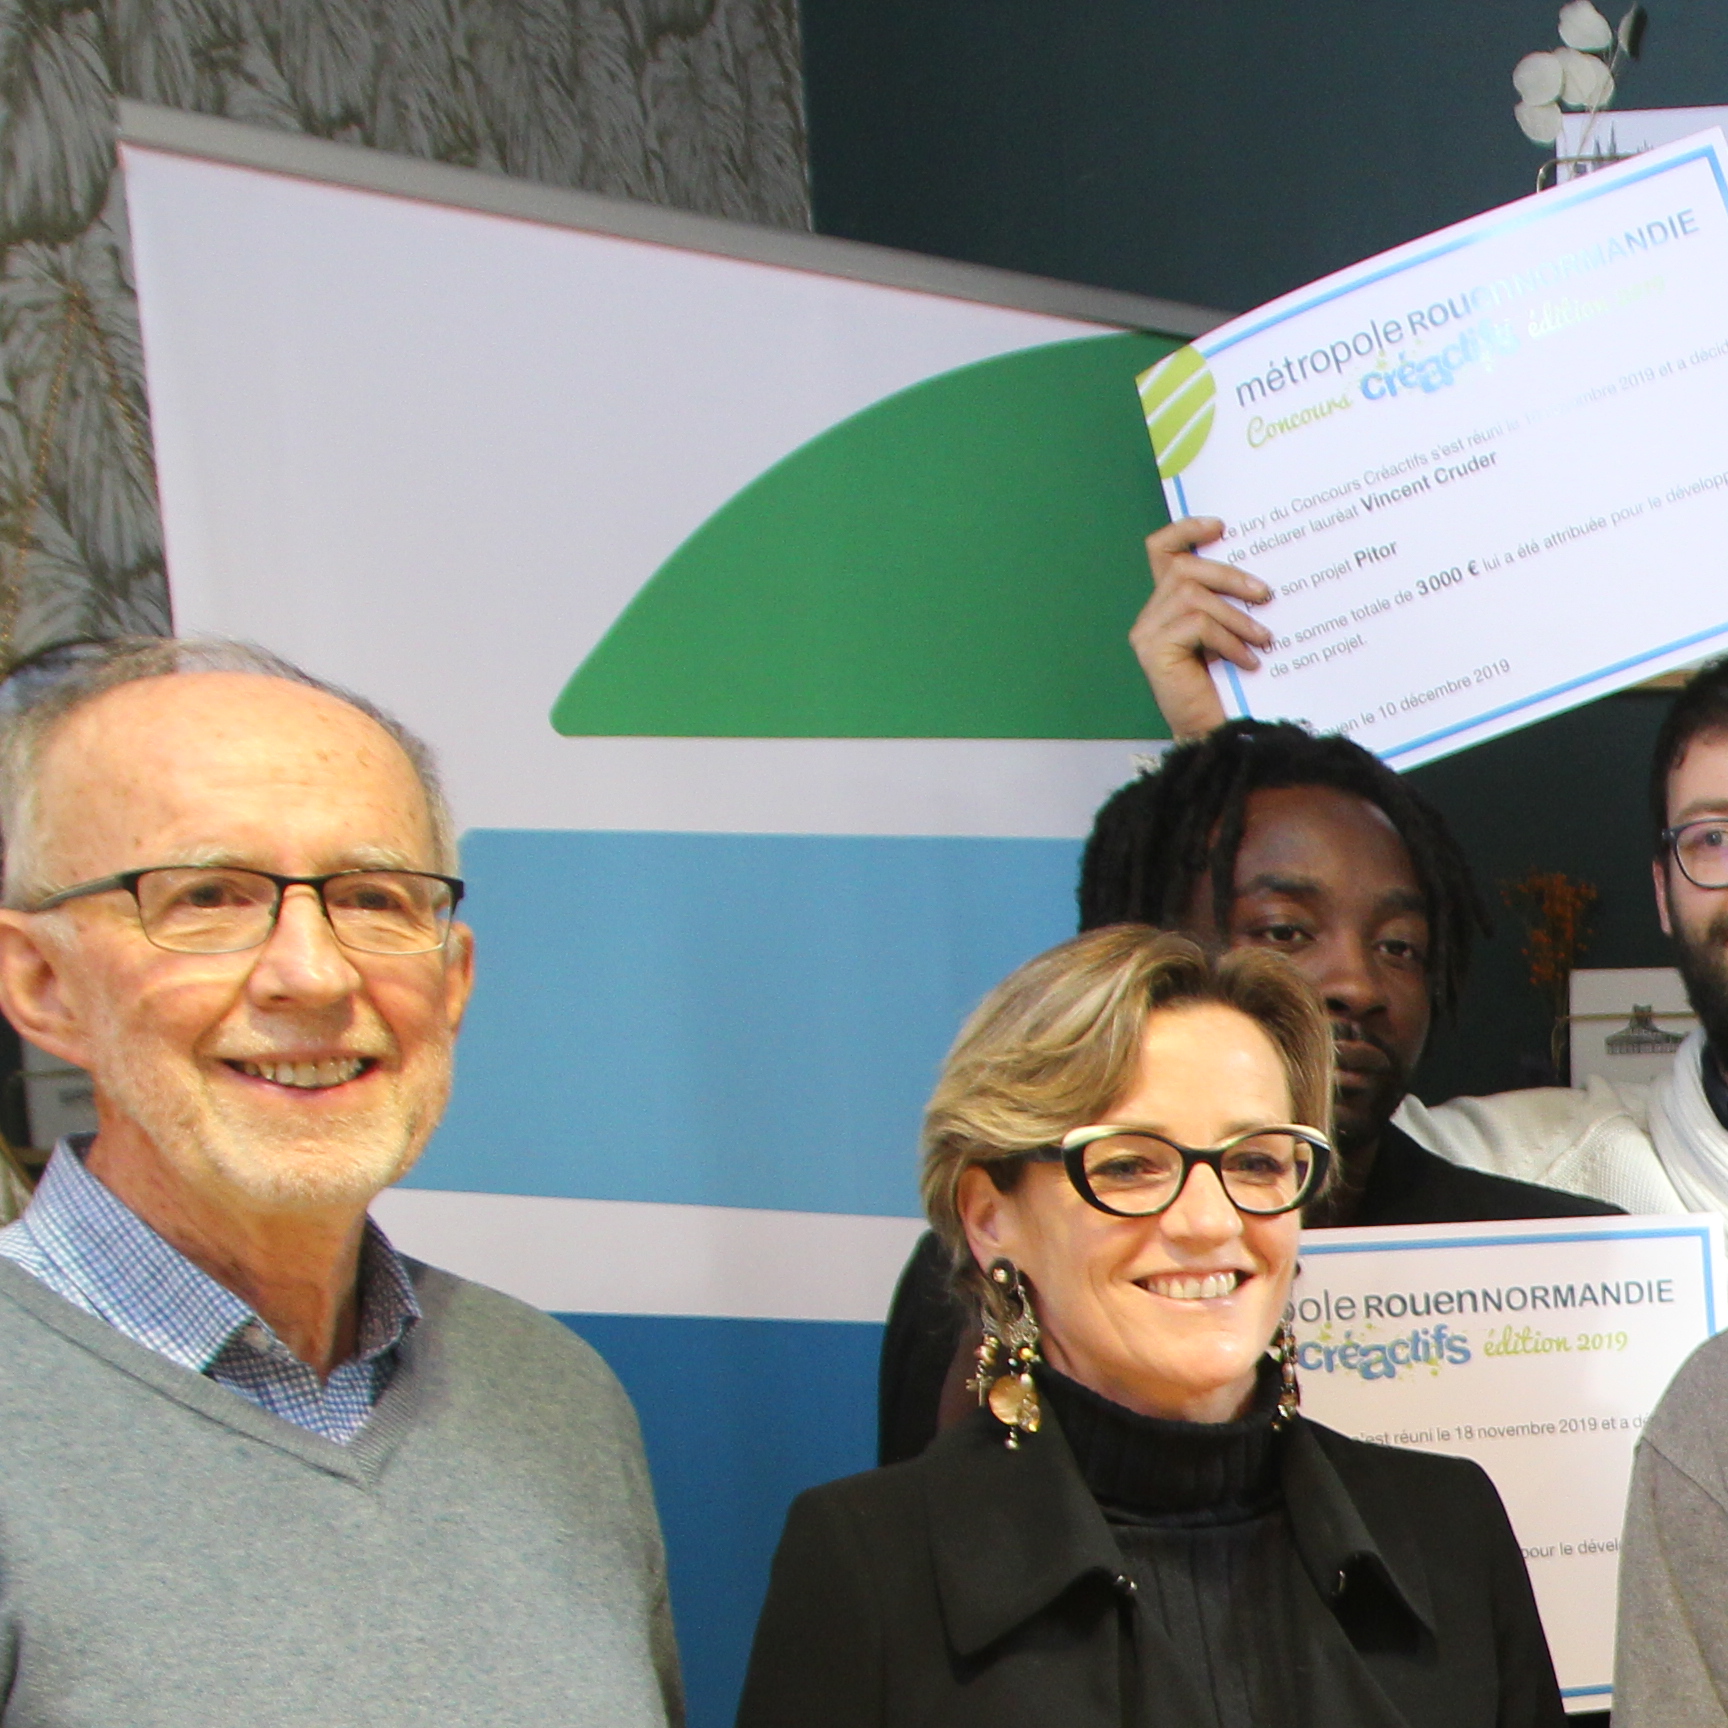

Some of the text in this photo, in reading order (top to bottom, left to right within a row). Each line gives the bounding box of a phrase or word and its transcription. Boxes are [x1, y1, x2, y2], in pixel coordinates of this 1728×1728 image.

[1234, 315, 1404, 408] métropole
[1245, 392, 1353, 449] Concours
[1227, 450, 1497, 564] de déclarer lauréat Vincent Cruder
[1281, 539, 1398, 597] son projet Pitor
[1294, 614, 1348, 643] somme
[1350, 596, 1392, 622] totale
[1394, 588, 1413, 605] de
[1482, 557, 1500, 573] lui
[1504, 553, 1514, 565] a
[1517, 539, 1540, 559] été
[1543, 516, 1608, 548] attribuée
[1610, 502, 1644, 527] pour
[1647, 496, 1662, 510] le
[1270, 633, 1368, 679] de son projet.
[1360, 657, 1511, 726] le 10 décembre 2019
[1483, 1325, 1571, 1358] édition
[1577, 1331, 1627, 1352] 2019
[1394, 1416, 1629, 1446] réuni le 18 novembre 2019 et a
